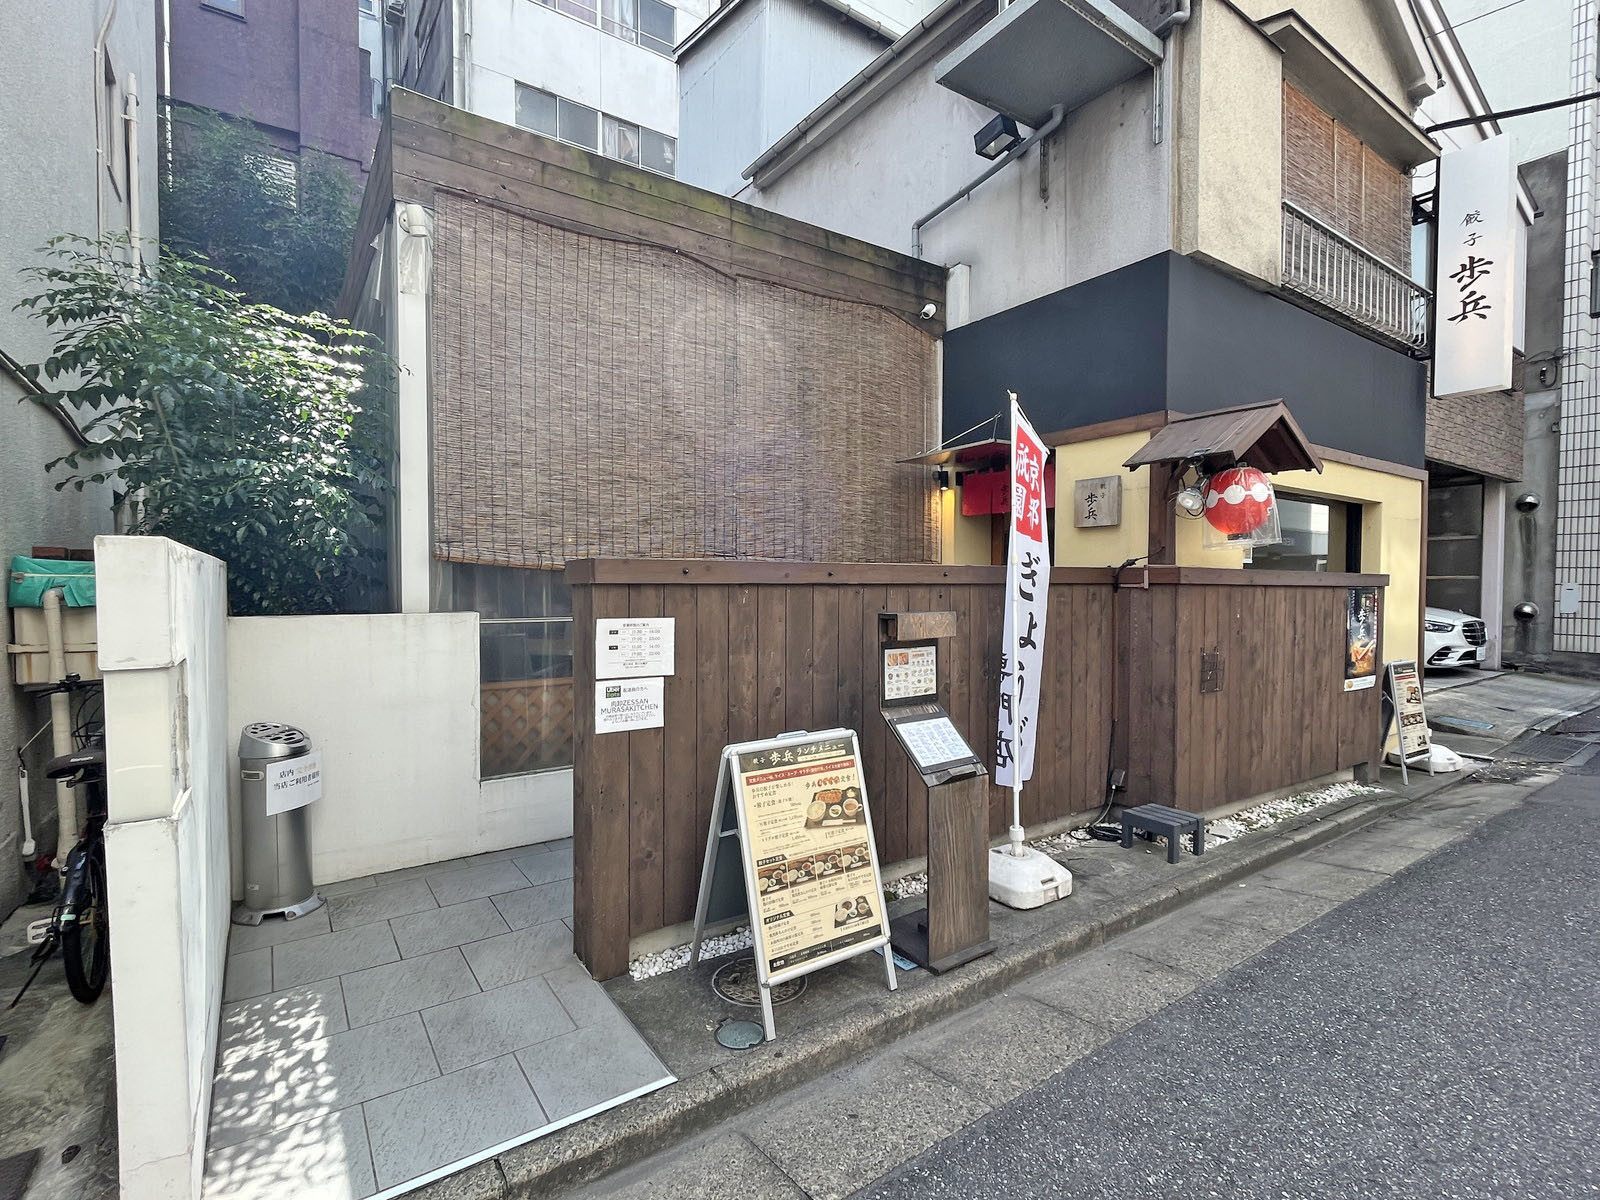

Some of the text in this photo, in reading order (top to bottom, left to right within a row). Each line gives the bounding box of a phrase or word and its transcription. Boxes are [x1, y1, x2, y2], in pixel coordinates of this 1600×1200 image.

[1447, 209, 1494, 325] 餃子 歩兵
[1084, 492, 1098, 521] 歩兵
[1017, 551, 1041, 746] ぎょう
[600, 704, 658, 714] MURASAKITCHEN
[769, 750, 794, 766] 歩兵
[796, 744, 845, 756] ランチメニュー
